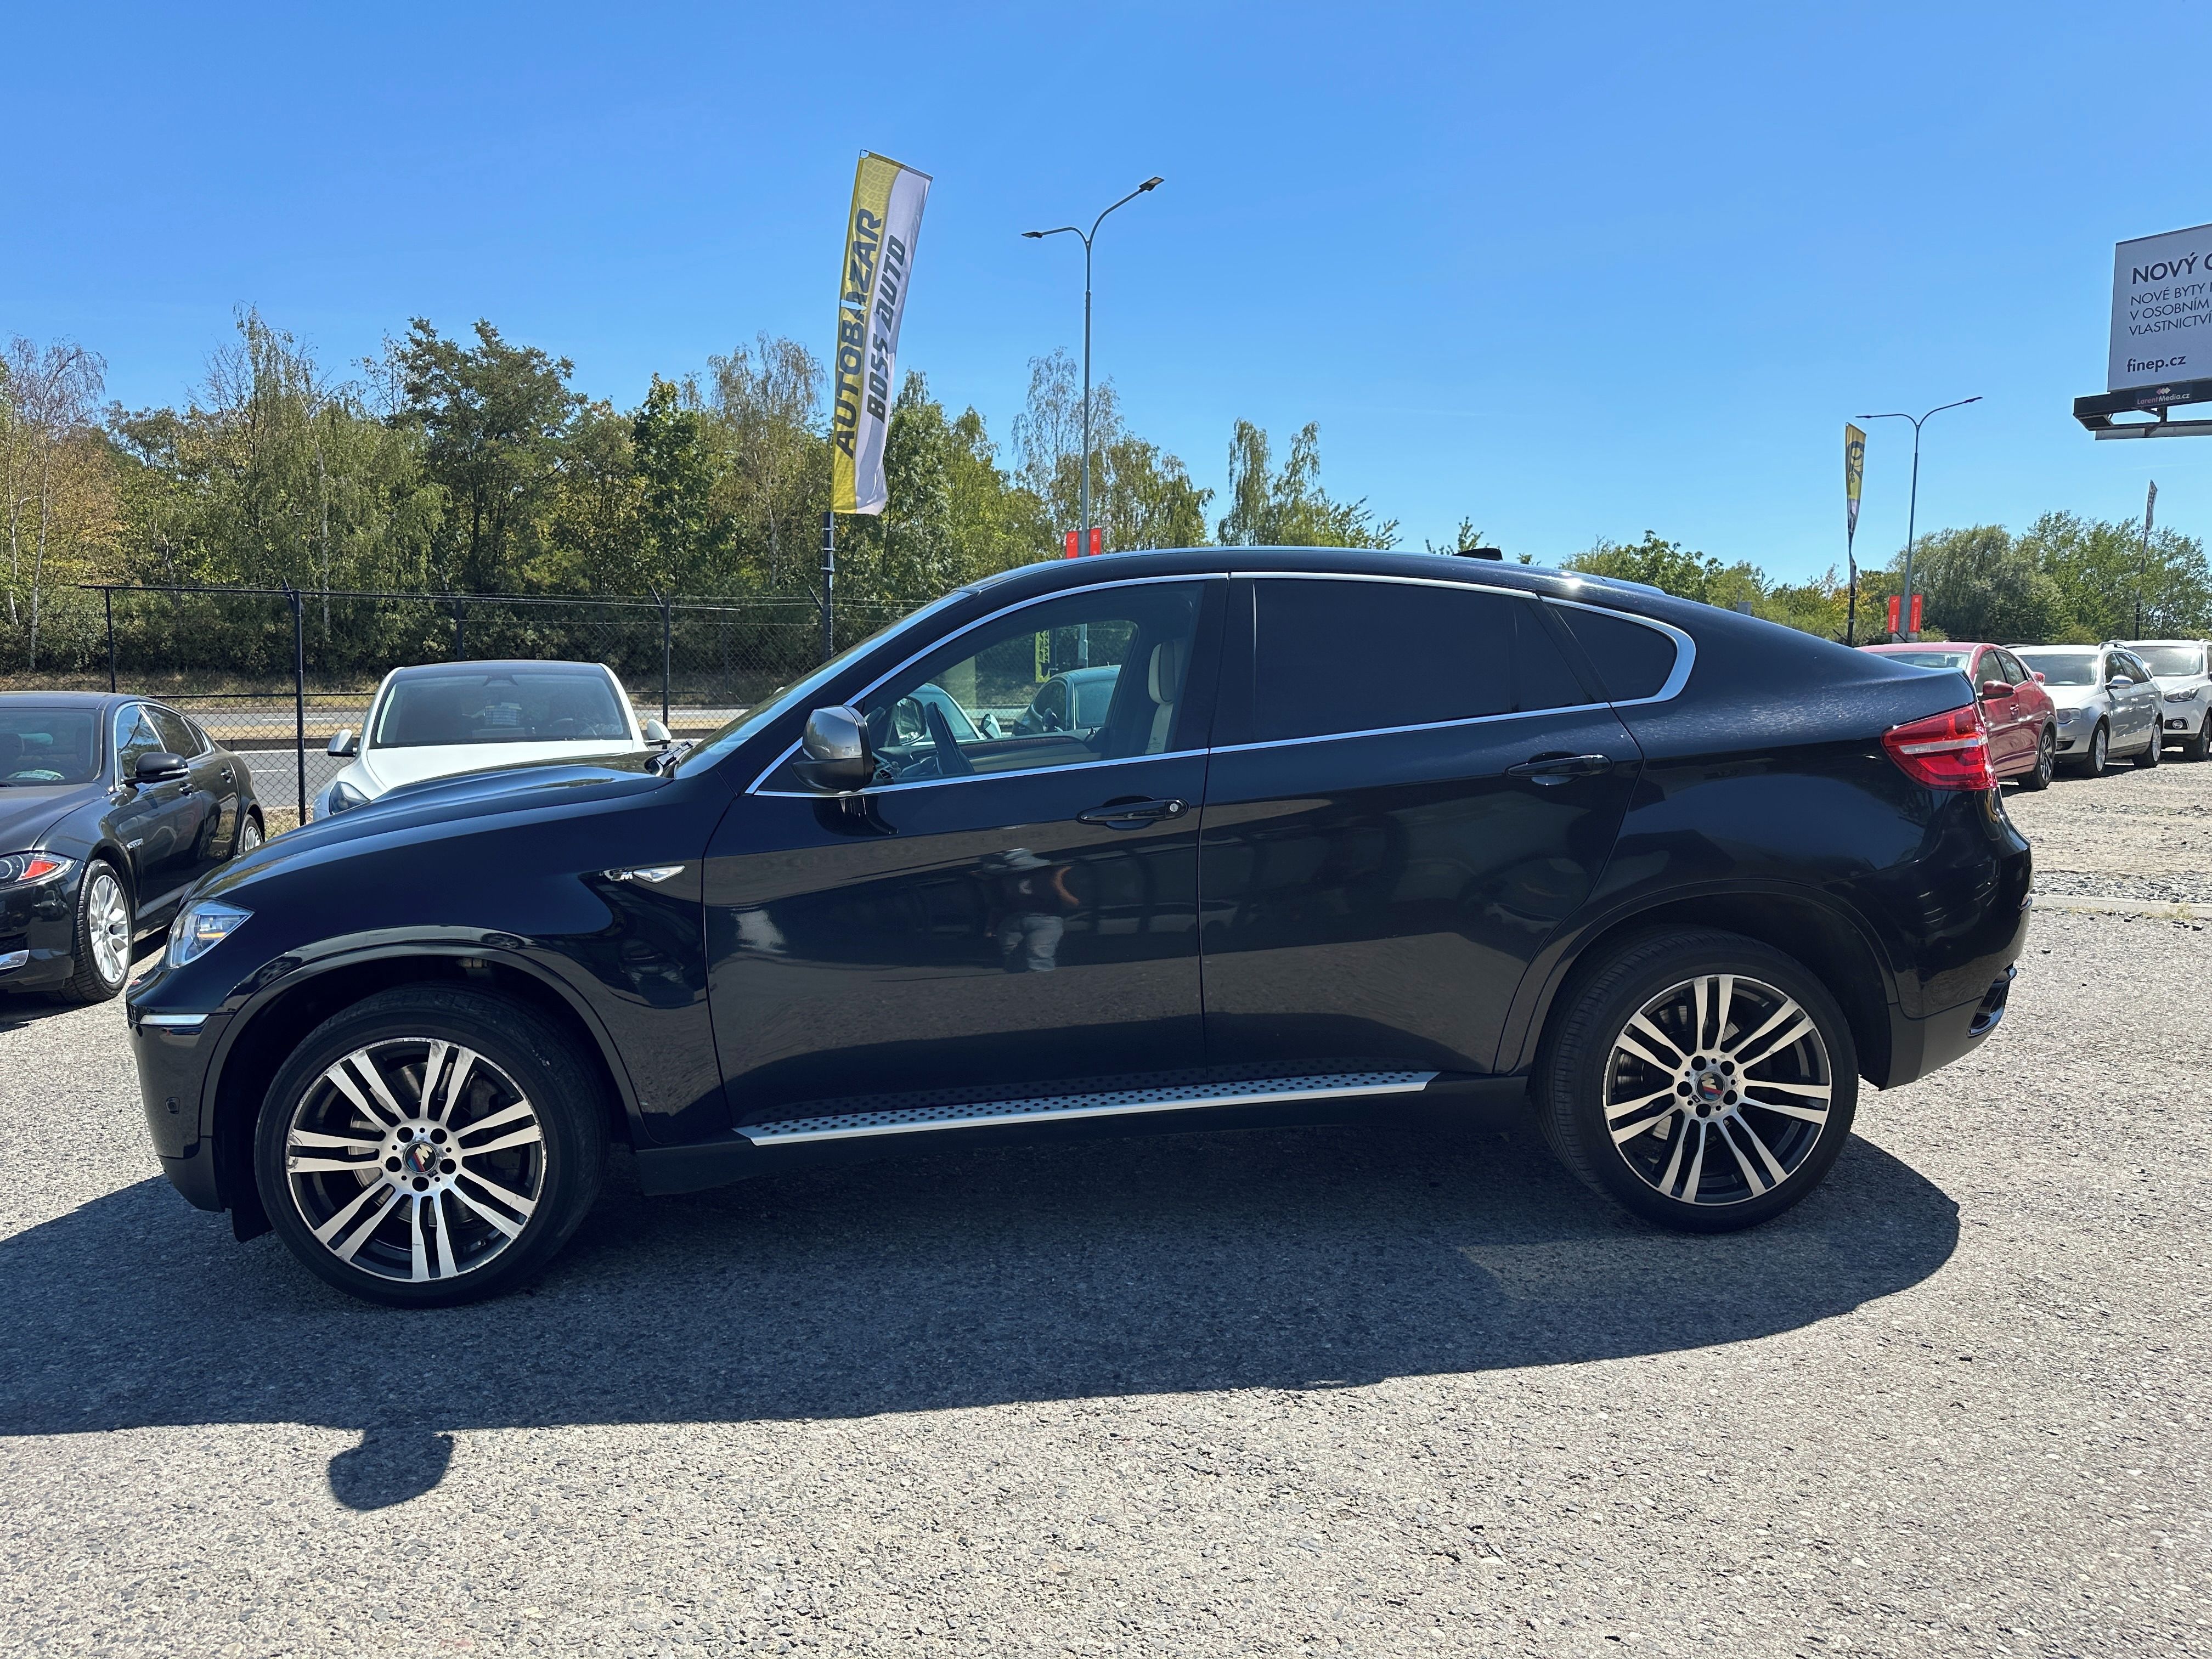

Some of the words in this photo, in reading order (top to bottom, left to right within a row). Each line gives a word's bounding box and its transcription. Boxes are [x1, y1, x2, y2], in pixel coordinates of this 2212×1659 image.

[2132, 252, 2198, 284] NOVÝ
[876, 235, 906, 333] AUTO
[2131, 286, 2170, 306] NOVÉ
[2174, 283, 2205, 298] BYTY
[2129, 309, 2212, 336] VLASTNICTVÍ
[2130, 310, 2139, 321] V
[2142, 297, 2209, 319] OSOBNÍM
[836, 208, 882, 460] AUTOBAZAR
[867, 332, 888, 424] BOSS
[2127, 356, 2186, 373] finep.cz
[2137, 393, 2190, 405] LarentMedia.cz
